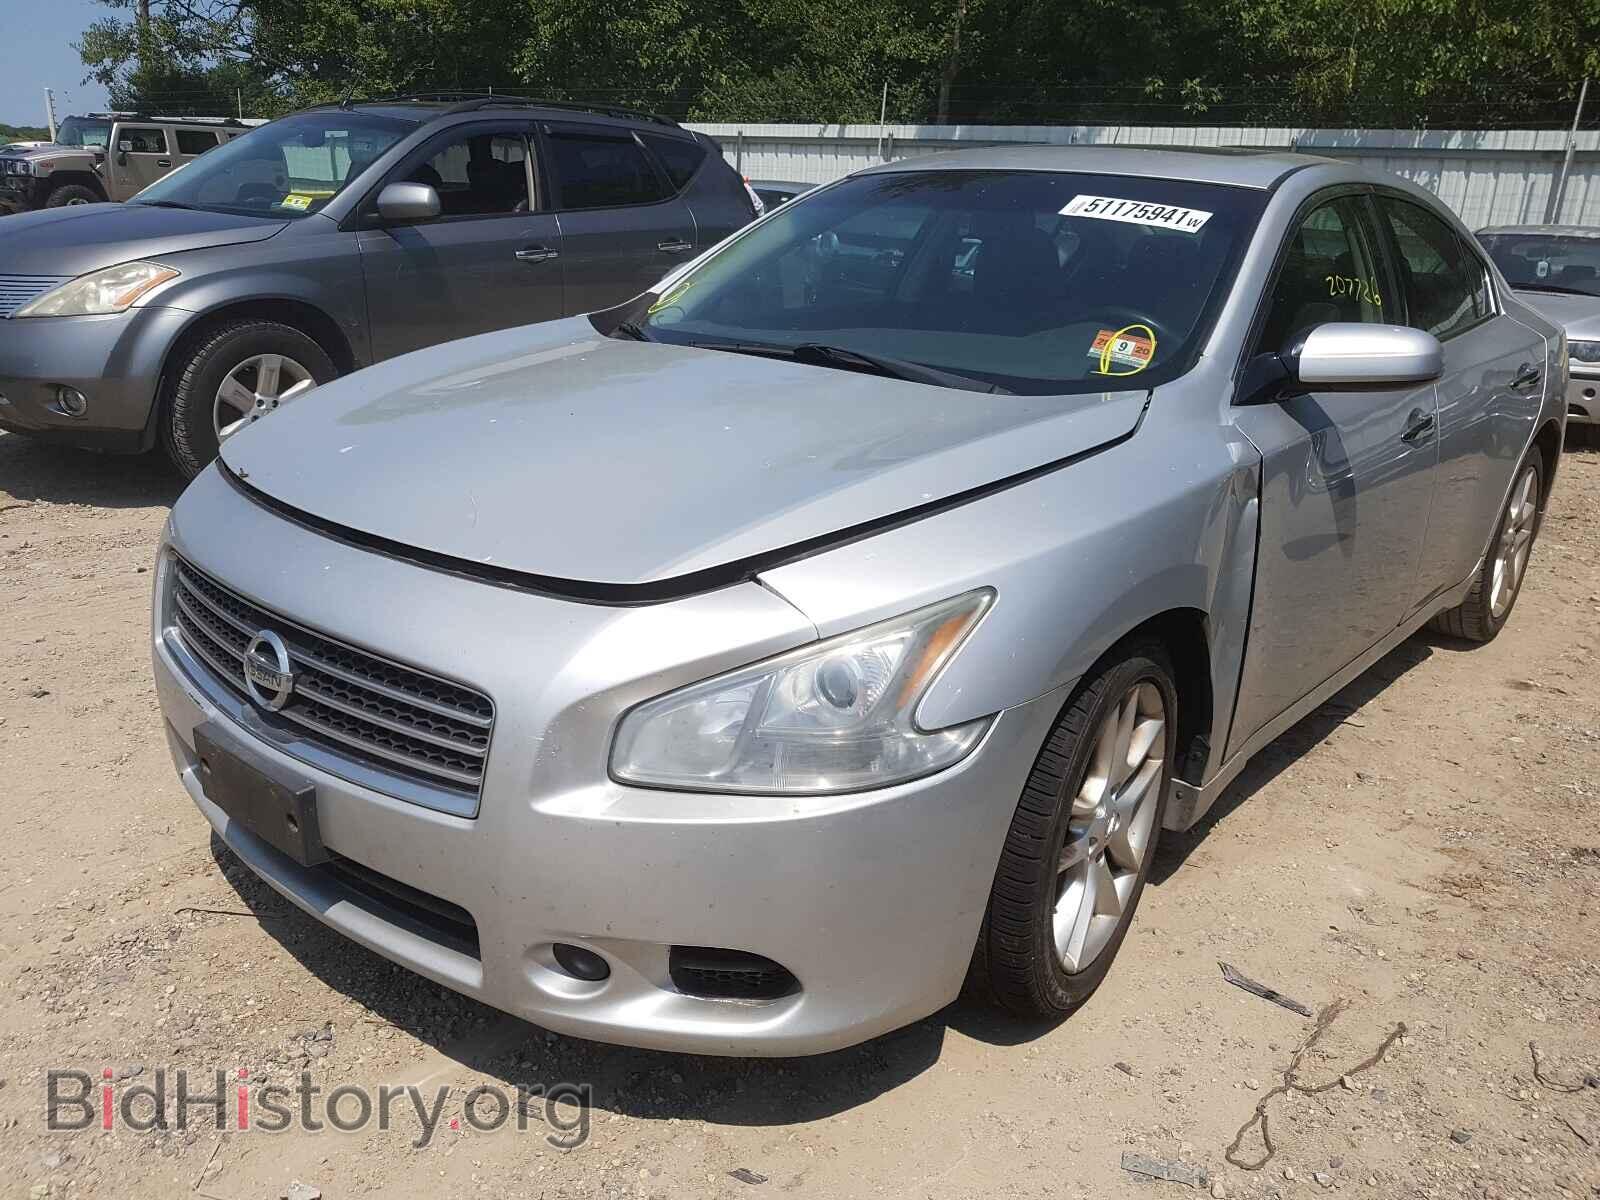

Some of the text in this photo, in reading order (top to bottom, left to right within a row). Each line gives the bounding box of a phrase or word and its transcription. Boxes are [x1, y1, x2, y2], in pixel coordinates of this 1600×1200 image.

[1325, 275, 1381, 306] 207726
[1118, 341, 1128, 352] 9
[1135, 346, 1150, 355] 20
